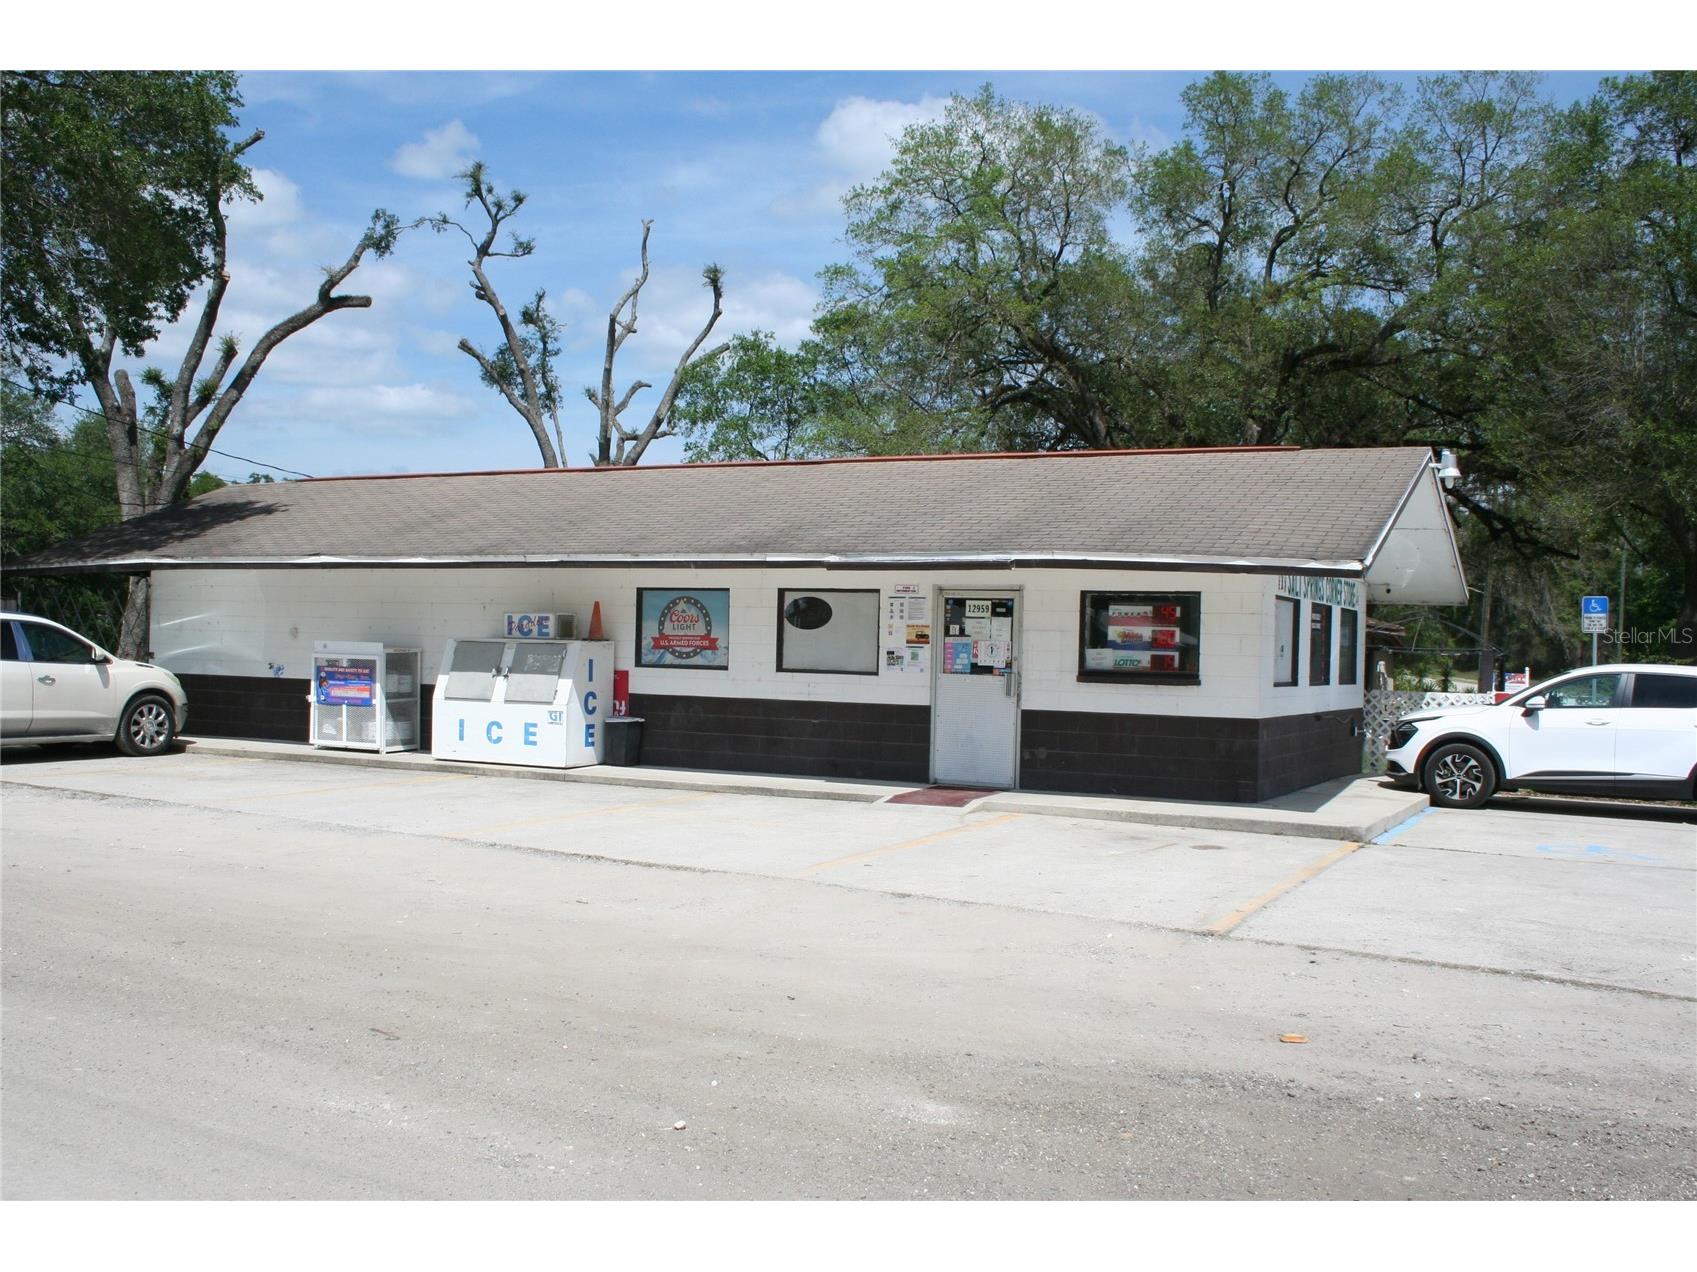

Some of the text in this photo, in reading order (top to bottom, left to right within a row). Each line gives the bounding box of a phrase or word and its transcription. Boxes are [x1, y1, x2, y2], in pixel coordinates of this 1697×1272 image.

[968, 604, 990, 613] 12959
[670, 609, 699, 623] Coors
[507, 614, 550, 636] ICE
[1113, 658, 1140, 666] LOTTO
[459, 718, 538, 746] ICE
